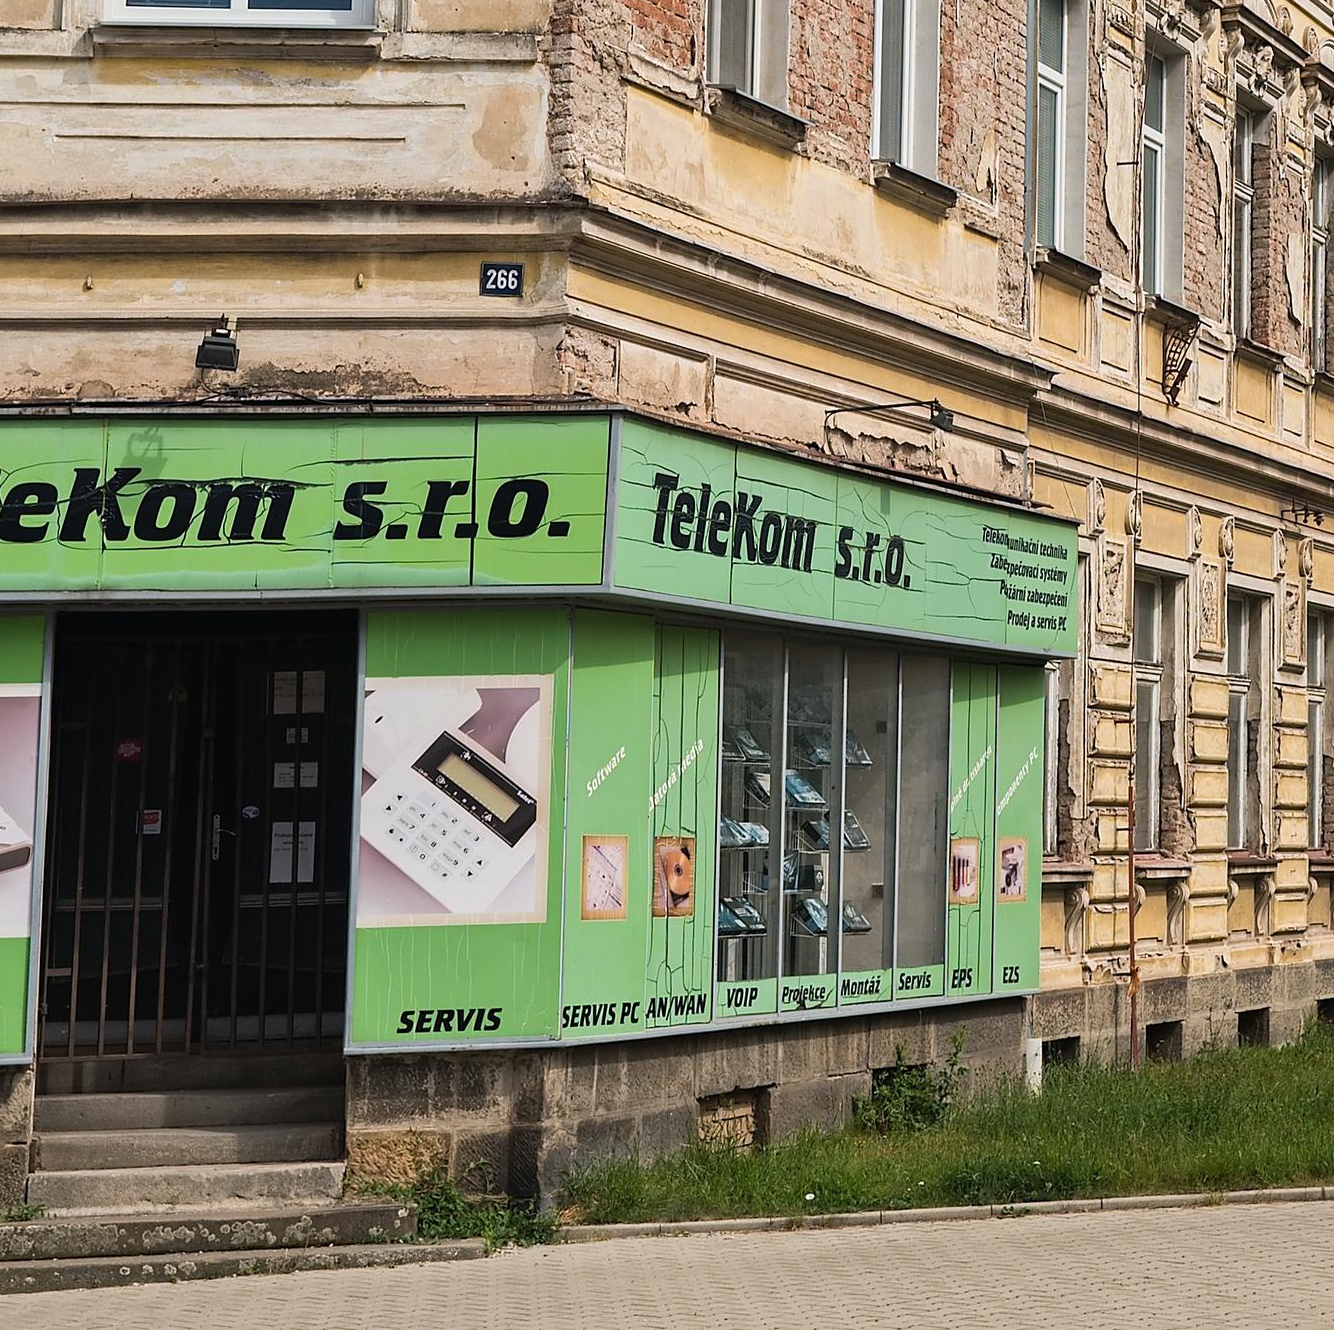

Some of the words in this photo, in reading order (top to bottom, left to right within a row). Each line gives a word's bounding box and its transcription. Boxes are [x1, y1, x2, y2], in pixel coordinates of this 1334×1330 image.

[486, 268, 518, 290] 266
[332, 476, 571, 541] s.r.o.
[652, 473, 817, 573] TeleKom
[834, 526, 911, 588] s.r.o.
[1040, 539, 1068, 560] technika
[1040, 566, 1068, 586] systémy
[1027, 588, 1068, 607] zabezpečení
[1007, 610, 1030, 630] Prodej
[1031, 615, 1036, 628] a
[1036, 615, 1057, 630] servis
[1057, 616, 1067, 631] PC
[586, 746, 627, 797] Software
[840, 975, 881, 997] Montáž
[898, 972, 931, 991] Servis
[951, 968, 973, 989] EPS
[1002, 966, 1020, 984] EZS
[726, 987, 759, 1009] VOIP
[396, 1007, 503, 1034] SERVIS
[562, 1002, 616, 1029] SERVIS
[619, 1001, 641, 1025] PC
